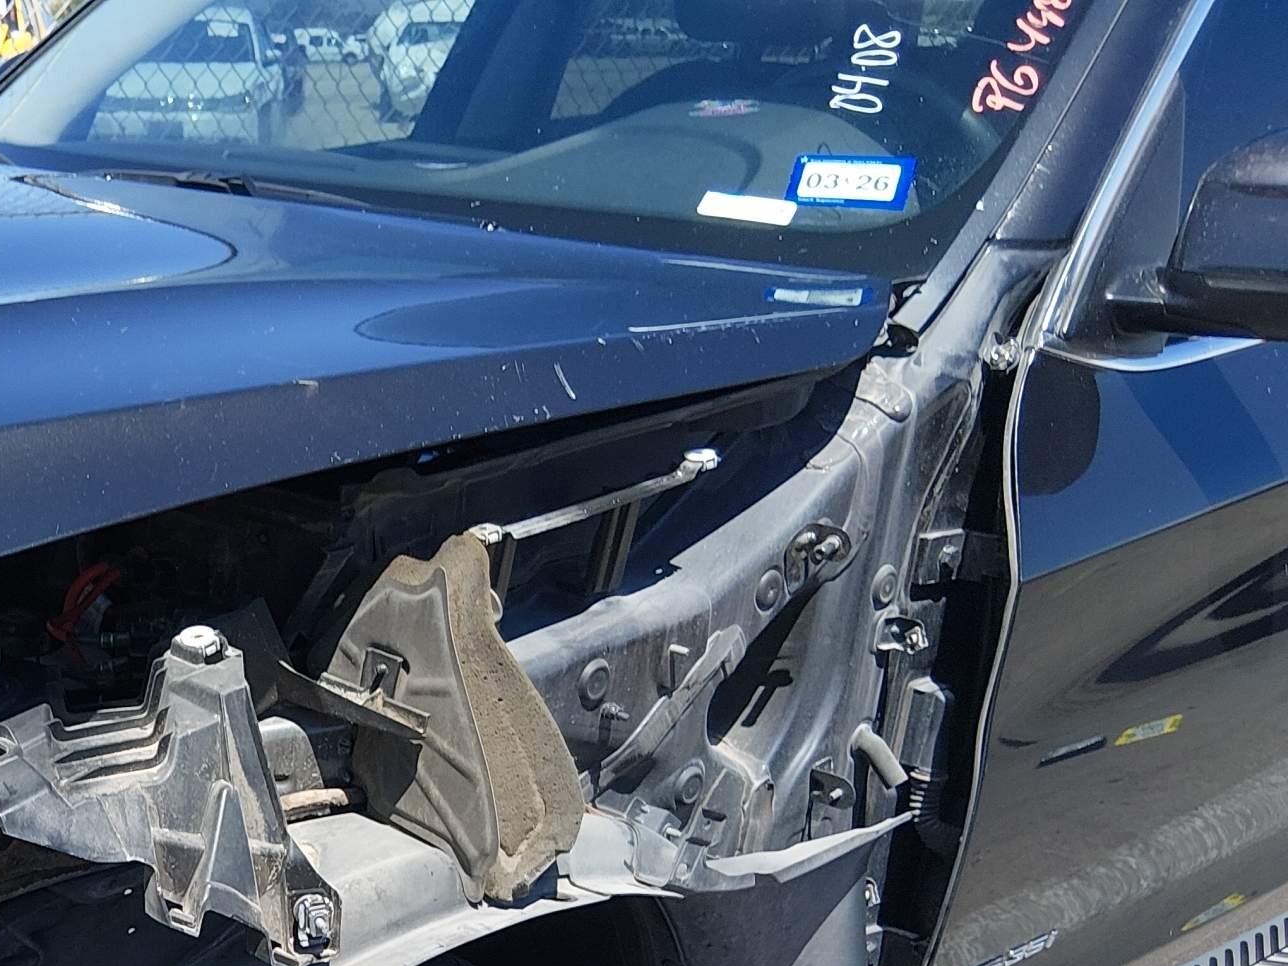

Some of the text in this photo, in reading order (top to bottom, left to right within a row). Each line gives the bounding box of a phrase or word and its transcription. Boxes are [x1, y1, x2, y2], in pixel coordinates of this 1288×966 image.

[829, 23, 902, 114] 04-08
[806, 172, 890, 193] 03 26
